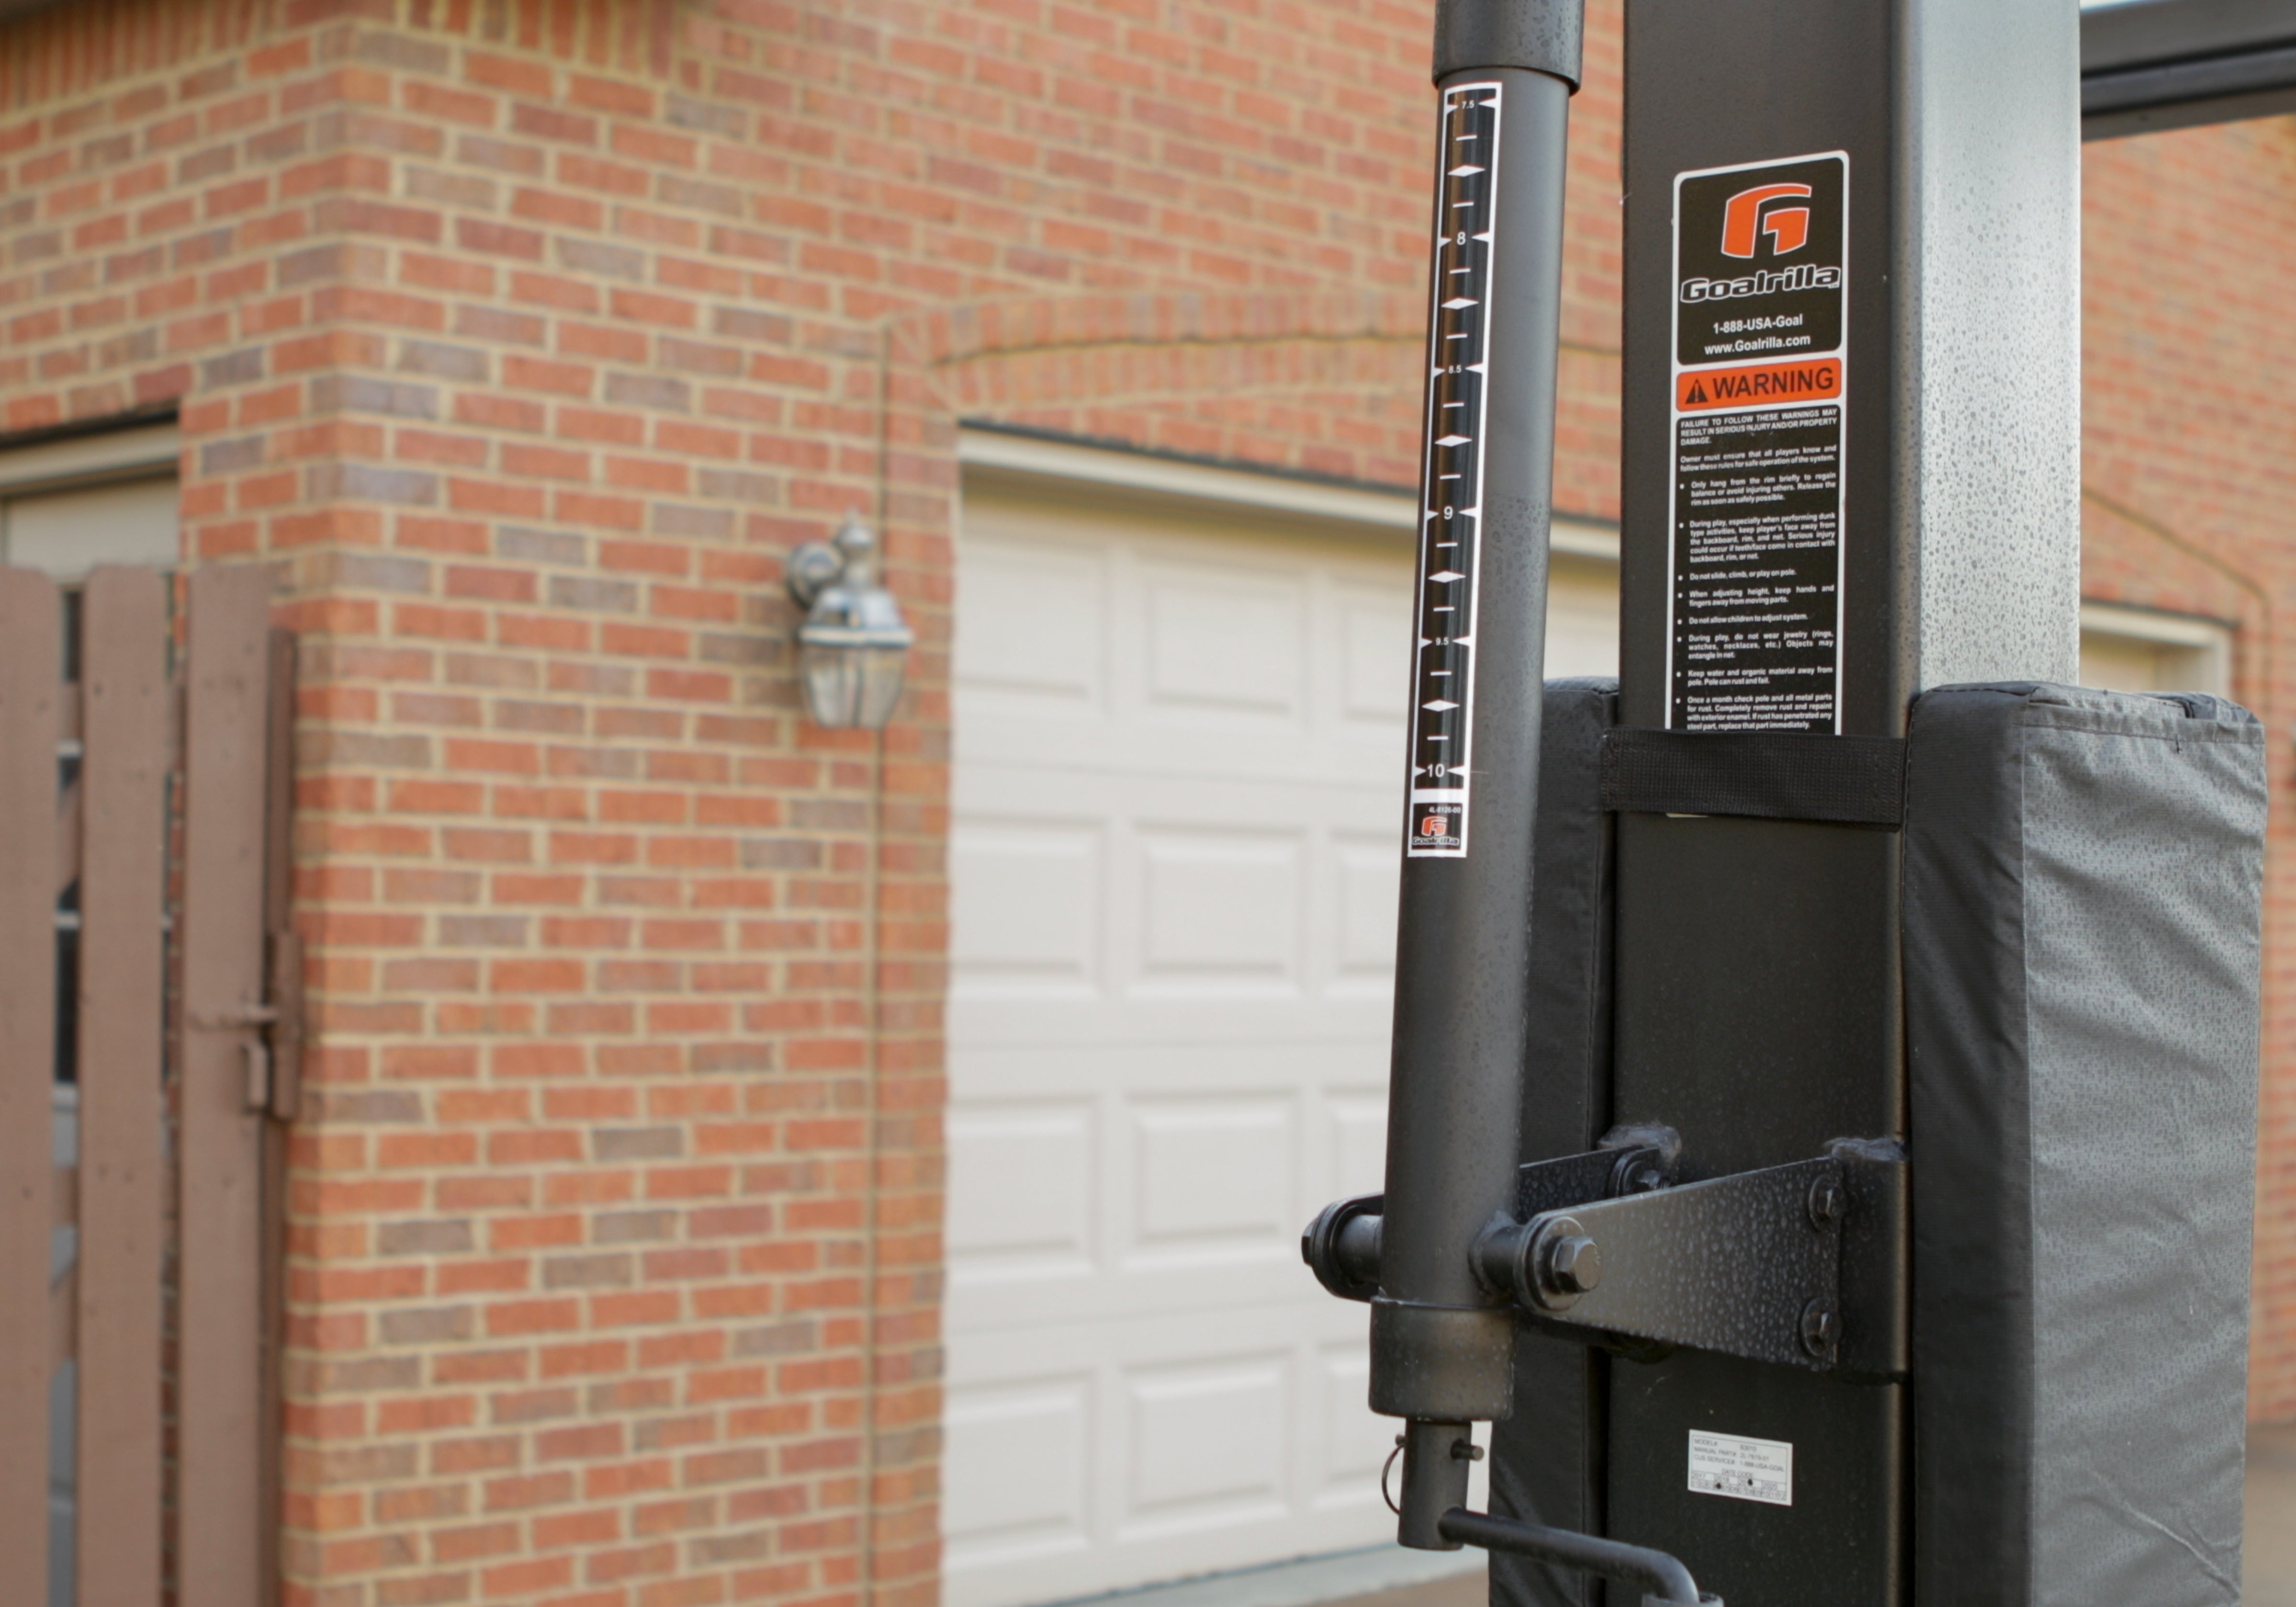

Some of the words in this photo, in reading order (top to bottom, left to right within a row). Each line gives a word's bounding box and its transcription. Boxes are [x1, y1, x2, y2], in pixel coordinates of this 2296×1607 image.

[1462, 101, 1474, 109] 7.5
[1457, 231, 1466, 245] 8
[1680, 264, 1841, 304] Goalrilla
[1713, 314, 1802, 334] 1-888-USA-Goal
[1704, 336, 1811, 355] www.Goalrilla.com
[1449, 365, 1462, 373] 8.5
[1712, 367, 1834, 399] WARNING
[1681, 419, 1709, 428] FAILURE
[1724, 415, 1753, 424] FOLLOW
[1756, 413, 1778, 421] THESE
[1781, 409, 1819, 419] WARNINGS
[1681, 428, 1706, 437] RESULT
[1715, 425, 1745, 434] SERIOUS
[1745, 423, 1770, 431] INJURY
[1771, 420, 1798, 429] AND/OR
[1799, 417, 1836, 427] PROPERTY
[1680, 436, 1711, 446] DAMAGE.
[1443, 506, 1453, 520] 9
[1436, 637, 1449, 645] 9.5
[1427, 764, 1444, 777] 10
